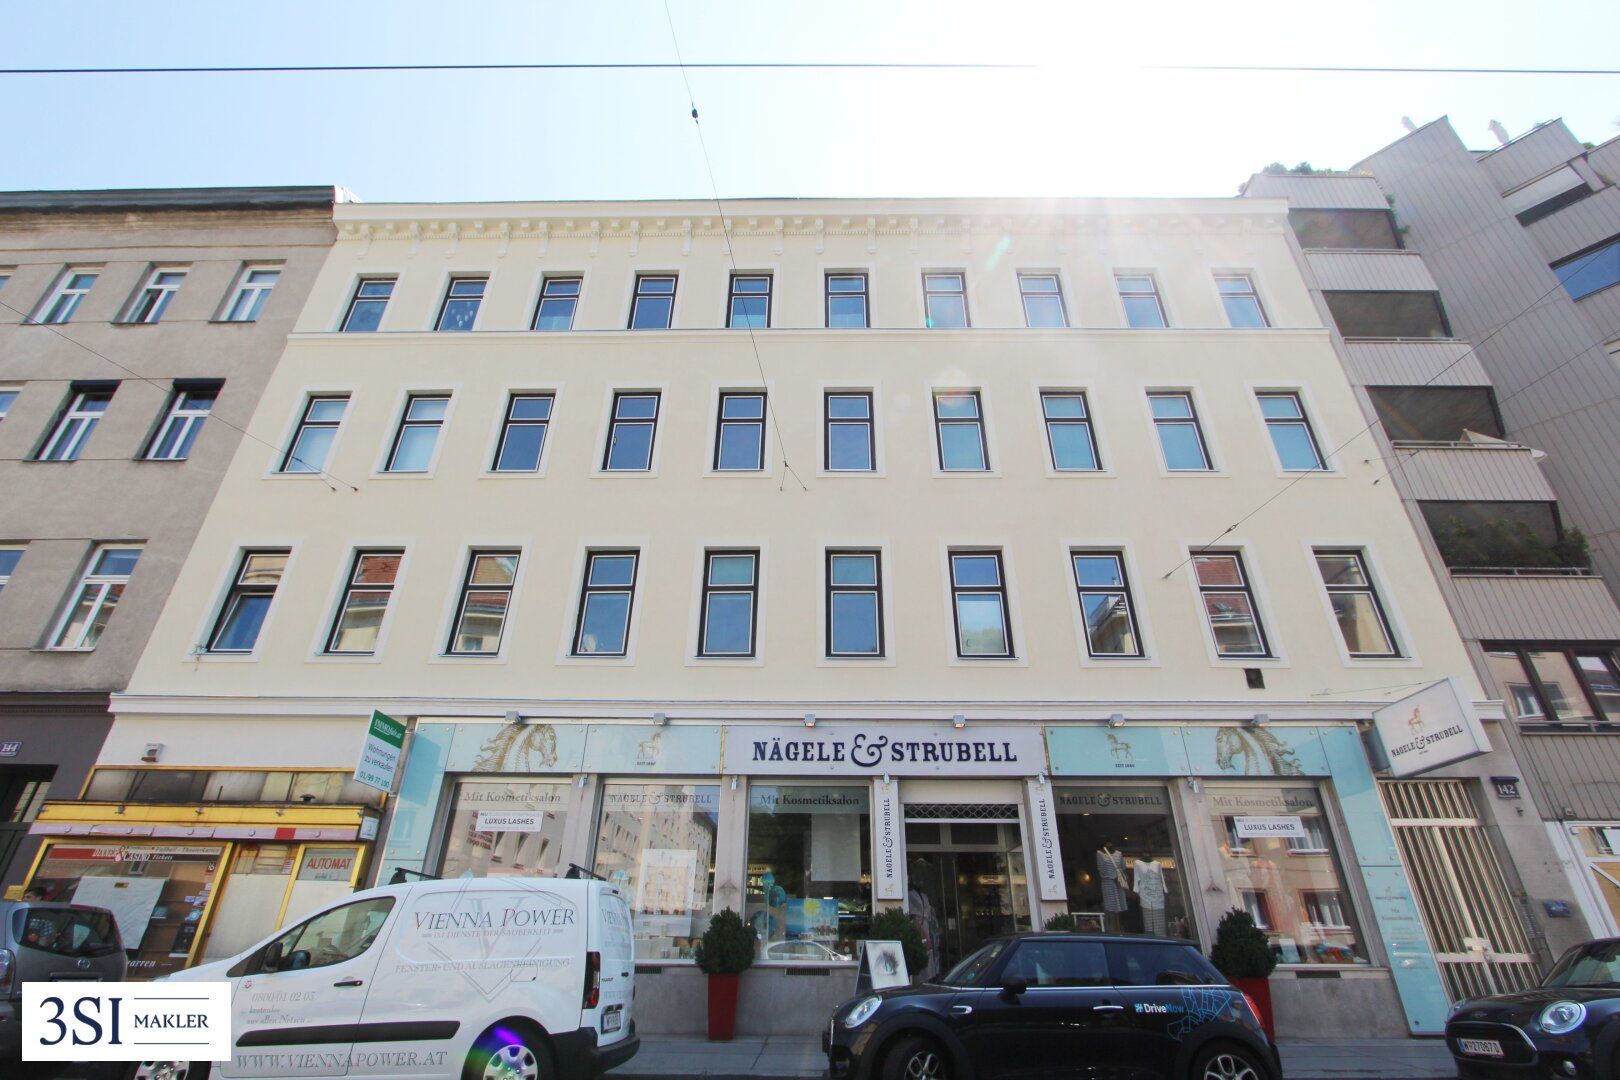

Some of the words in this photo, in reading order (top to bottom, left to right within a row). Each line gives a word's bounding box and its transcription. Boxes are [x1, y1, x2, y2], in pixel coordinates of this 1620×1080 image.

[1425, 724, 1463, 745] STRUBELL
[752, 737, 845, 762] NÄGELE
[851, 733, 888, 768] &
[891, 741, 1018, 762] STRUBELL
[1497, 784, 1516, 795] 142
[464, 791, 483, 801] Mit
[486, 791, 561, 802] Kosmetiksalon
[664, 794, 712, 804] STRUBELL
[760, 794, 779, 805] Mit
[783, 794, 860, 805] Kosmetiksalon
[1112, 796, 1163, 806] STRUBELL
[1212, 796, 1233, 807] Mit
[1235, 796, 1314, 807] Kosmetiksalon
[883, 798, 891, 836] STRUBELL
[1039, 798, 1050, 837] STRUBELL
[1243, 823, 1267, 831] LUXUS
[1267, 823, 1296, 831] LASHES
[306, 858, 353, 870] AUTOMAT
[414, 911, 493, 931] VIENNA
[500, 908, 575, 927] POWER
[236, 1051, 448, 1069] WWW.VIENNAPOWER.AT
